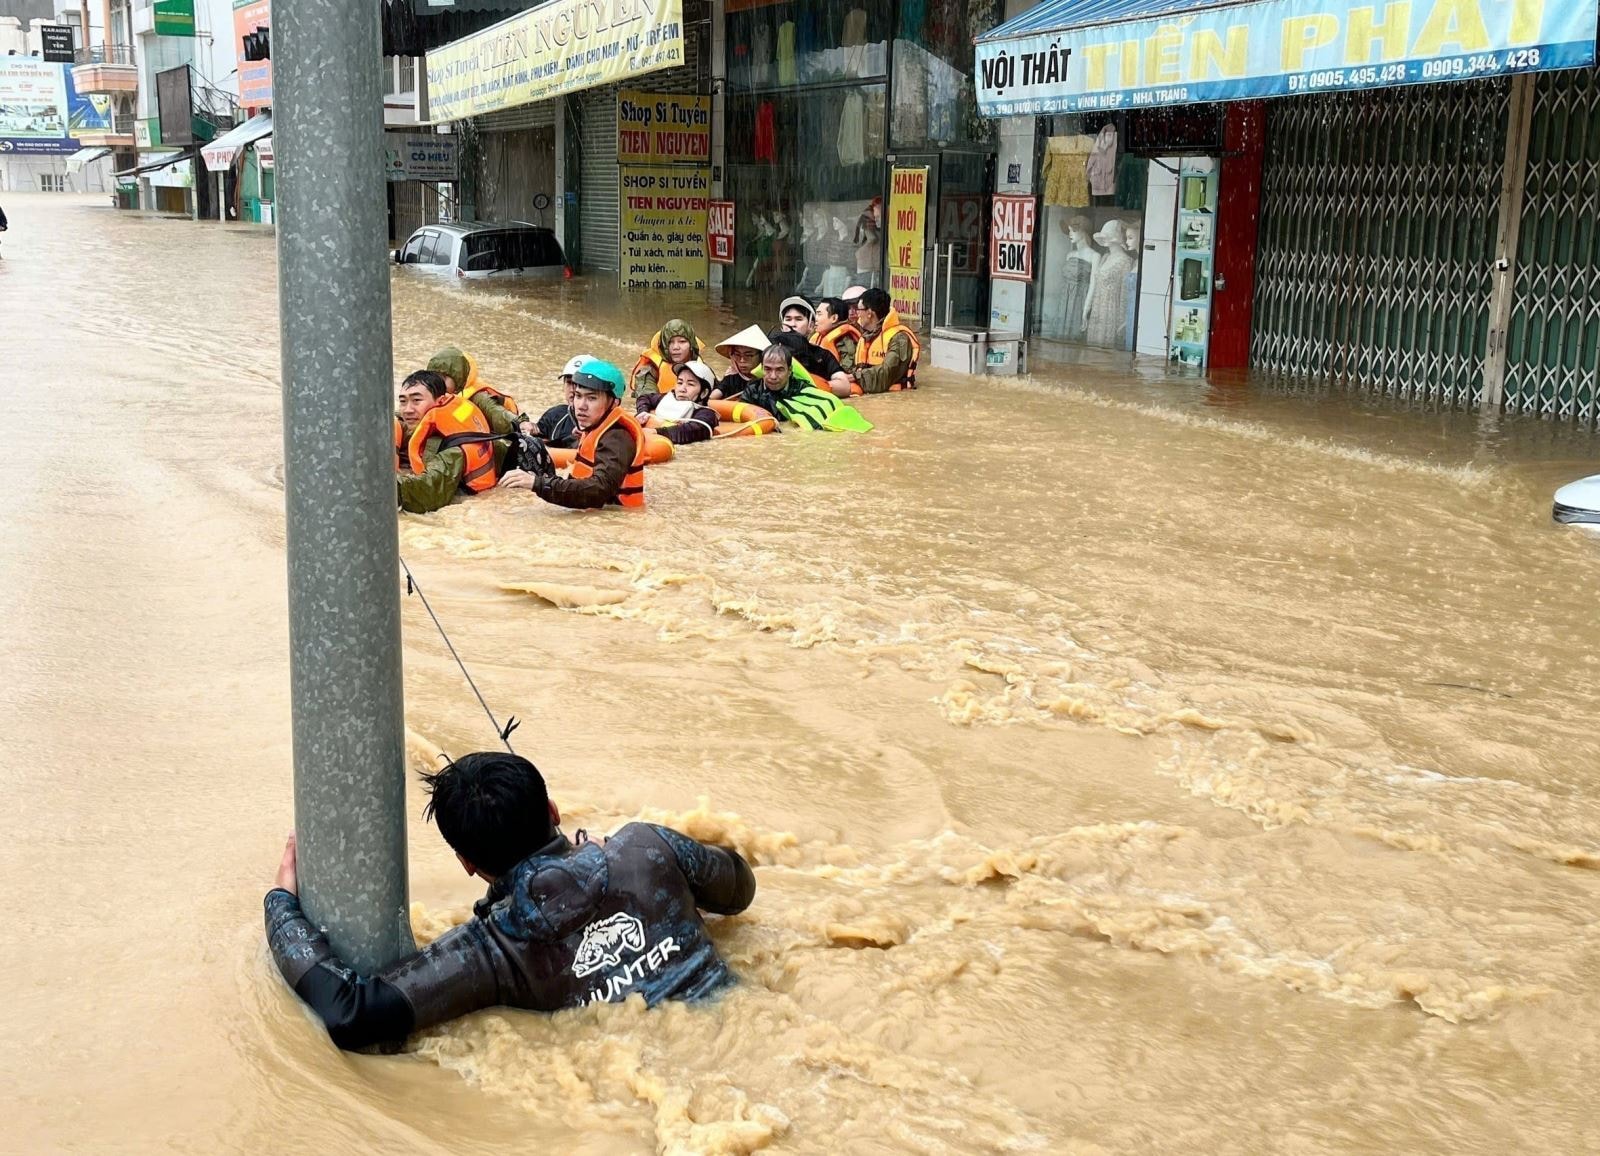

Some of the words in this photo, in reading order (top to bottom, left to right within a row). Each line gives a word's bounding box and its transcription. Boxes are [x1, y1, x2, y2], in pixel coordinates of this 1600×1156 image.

[602, 40, 620, 60] NAM
[1081, 16, 1249, 90] TIẾN
[982, 50, 1014, 95] NỘI
[1021, 38, 1071, 86] THẤT
[1309, 64, 1406, 88] 0905.495.428
[1133, 91, 1153, 105] NHA
[1155, 88, 1187, 102] TRANG
[621, 101, 652, 127] Shop
[671, 96, 708, 128] Tuyển
[620, 130, 651, 154] TIEN
[656, 131, 709, 156] NGUYEN
[624, 175, 656, 188] SHOP
[672, 170, 707, 189] TUYỂN
[894, 170, 923, 195] HÀNG
[627, 196, 653, 209] TIEN
[656, 197, 706, 210] NGUYEN
[709, 206, 734, 236] SALE
[897, 206, 917, 232] MỚI
[994, 200, 1035, 242] SALE
[899, 240, 912, 268] VỀ
[998, 243, 1026, 272] 50K
[630, 263, 646, 275] phụ
[578, 937, 681, 1007] UNTER
